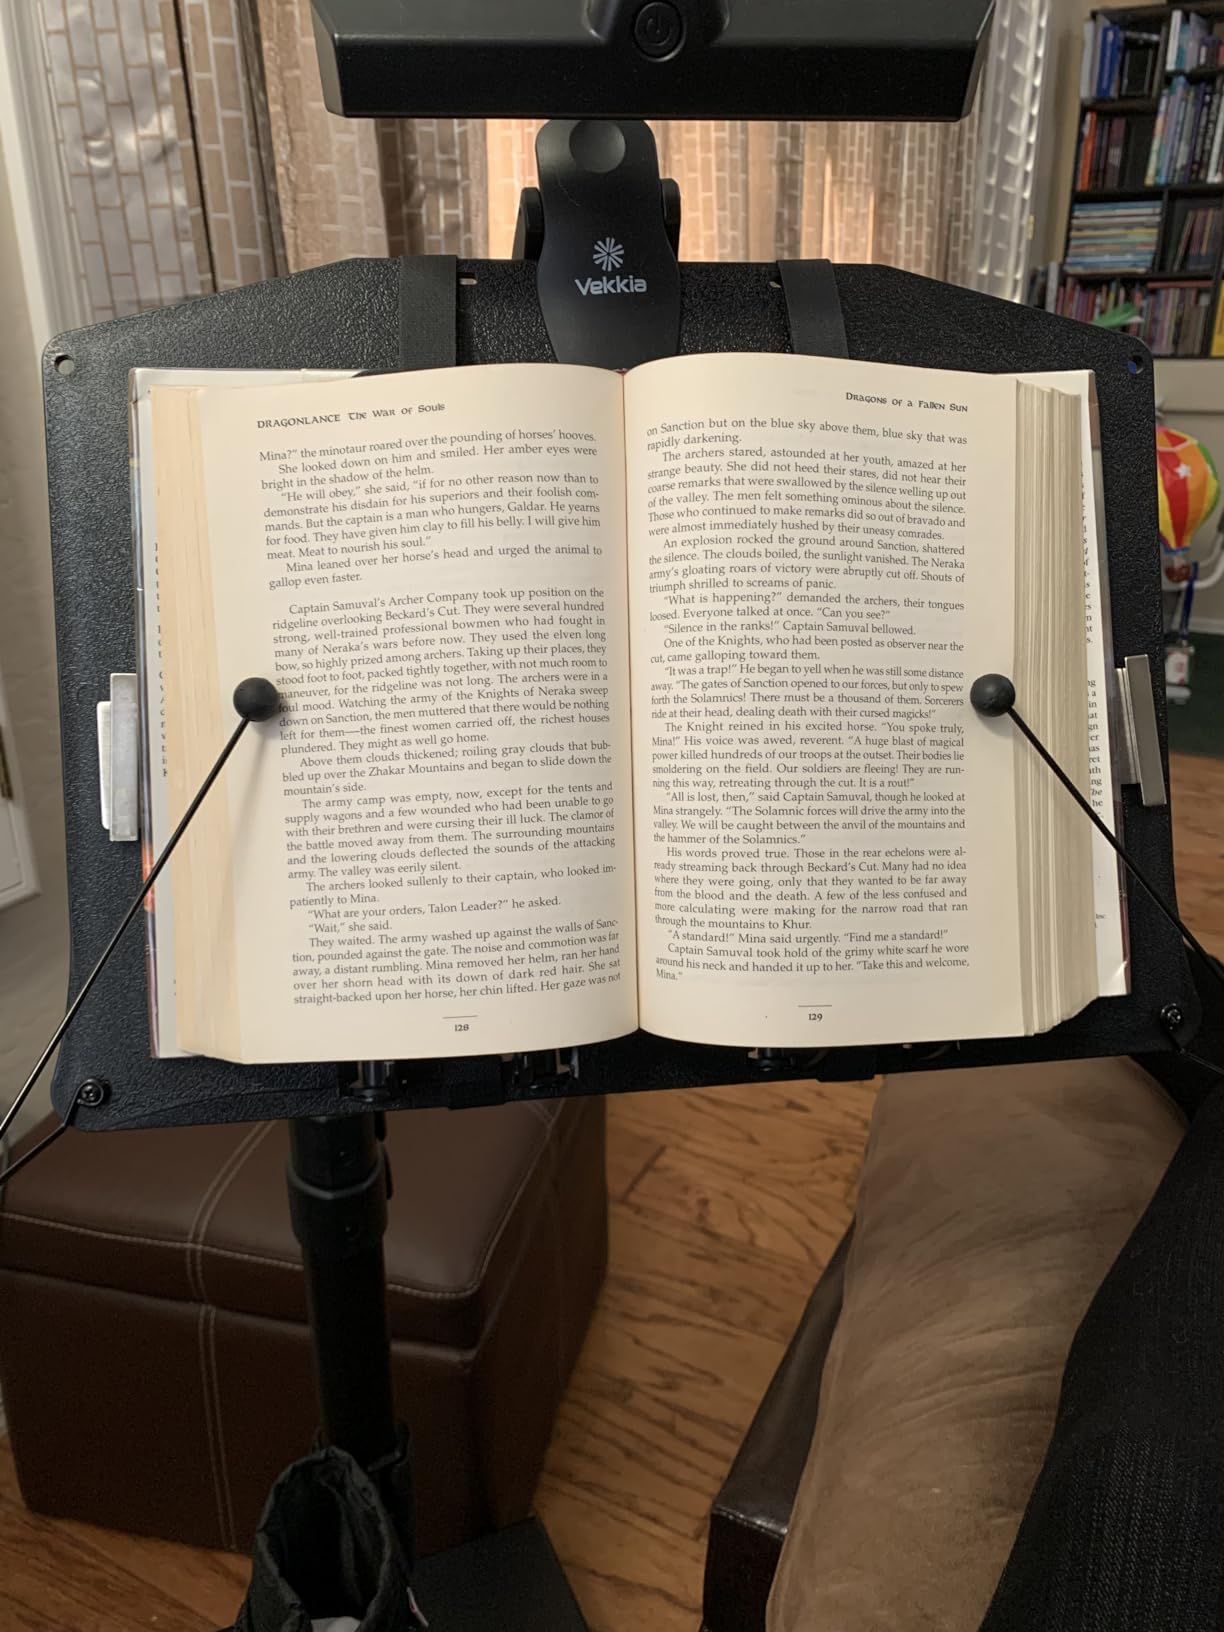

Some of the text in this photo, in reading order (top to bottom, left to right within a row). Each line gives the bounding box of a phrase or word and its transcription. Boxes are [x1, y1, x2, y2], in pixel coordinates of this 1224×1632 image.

[574, 275, 648, 296] Vekkia
[256, 416, 340, 428] DRAGONLANCE
[660, 420, 704, 433] Sanction
[708, 418, 727, 428] but
[750, 417, 767, 428] the
[770, 418, 794, 429] blue
[797, 420, 815, 432] sky
[819, 421, 848, 433] above
[852, 425, 879, 438] them,
[882, 428, 903, 439] blue
[906, 430, 922, 443] sky
[926, 432, 945, 443] that
[300, 447, 316, 458] the
[319, 445, 366, 456] minotaur
[369, 439, 402, 451] roared
[404, 440, 428, 448] over
[430, 434, 447, 445] the
[449, 431, 502, 445] pounding
[504, 430, 515, 440] of
[558, 430, 596, 441] hooves.
[647, 433, 741, 452] rapidly darkening.
[261, 465, 433, 492] bright in the shadow of the helm.
[648, 520, 944, 540] were almost immediately hushed by their uneasy comrades.
[266, 550, 295, 560] meat.
[298, 546, 324, 557] Meat
[327, 546, 338, 555] to
[340, 542, 380, 554] nourish
[383, 539, 398, 550] his
[268, 576, 301, 589] gallop
[331, 572, 361, 583] faster.
[649, 581, 686, 595] triumph
[688, 578, 728, 589] shrilled
[732, 579, 744, 588] to
[792, 578, 802, 588] of
[805, 580, 836, 591] panic.
[288, 602, 330, 616] Captain
[388, 594, 423, 606] Archer
[426, 590, 478, 604] Company
[482, 589, 507, 599] took
[510, 591, 524, 600] up
[528, 588, 571, 599] position
[589, 587, 604, 597] the
[706, 623, 716, 632] in
[719, 621, 737, 631] the
[782, 621, 824, 633] Captain
[826, 622, 868, 633] Samuval
[871, 624, 916, 635] bellowed.
[650, 654, 665, 665] cut,
[694, 650, 746, 662] galloping
[748, 649, 787, 660] toward
[790, 650, 820, 660] them.
[280, 742, 336, 756] plundered.
[341, 740, 364, 752] They
[367, 737, 398, 750] might
[414, 735, 437, 746] well
[440, 737, 454, 746] go
[456, 732, 488, 743] home.
[342, 782, 366, 792] side.
[653, 832, 665, 843] the
[667, 833, 706, 844] hammer
[708, 834, 720, 844] of
[722, 834, 740, 844] the
[288, 872, 316, 881] army.
[320, 867, 338, 877] The
[340, 865, 371, 878] valley
[397, 862, 426, 875] eerily
[429, 860, 461, 871] silent.
[289, 893, 379, 908] patiently to Mina.
[362, 910, 386, 919] your
[388, 905, 425, 917] orders,
[430, 903, 457, 914] Talon
[512, 898, 525, 909] he
[528, 896, 560, 908] asked.
[348, 922, 365, 932] she
[368, 920, 392, 931] said.
[654, 915, 812, 929] through the mountains to Khur.
[738, 933, 766, 944] Mina
[769, 934, 792, 944] said
[795, 933, 840, 945] urgently.
[294, 973, 620, 1006] straight-backed upon her horse, her chin lifted. Her gaze was not
[808, 1013, 823, 1022] 129
[454, 1024, 470, 1032] 128
